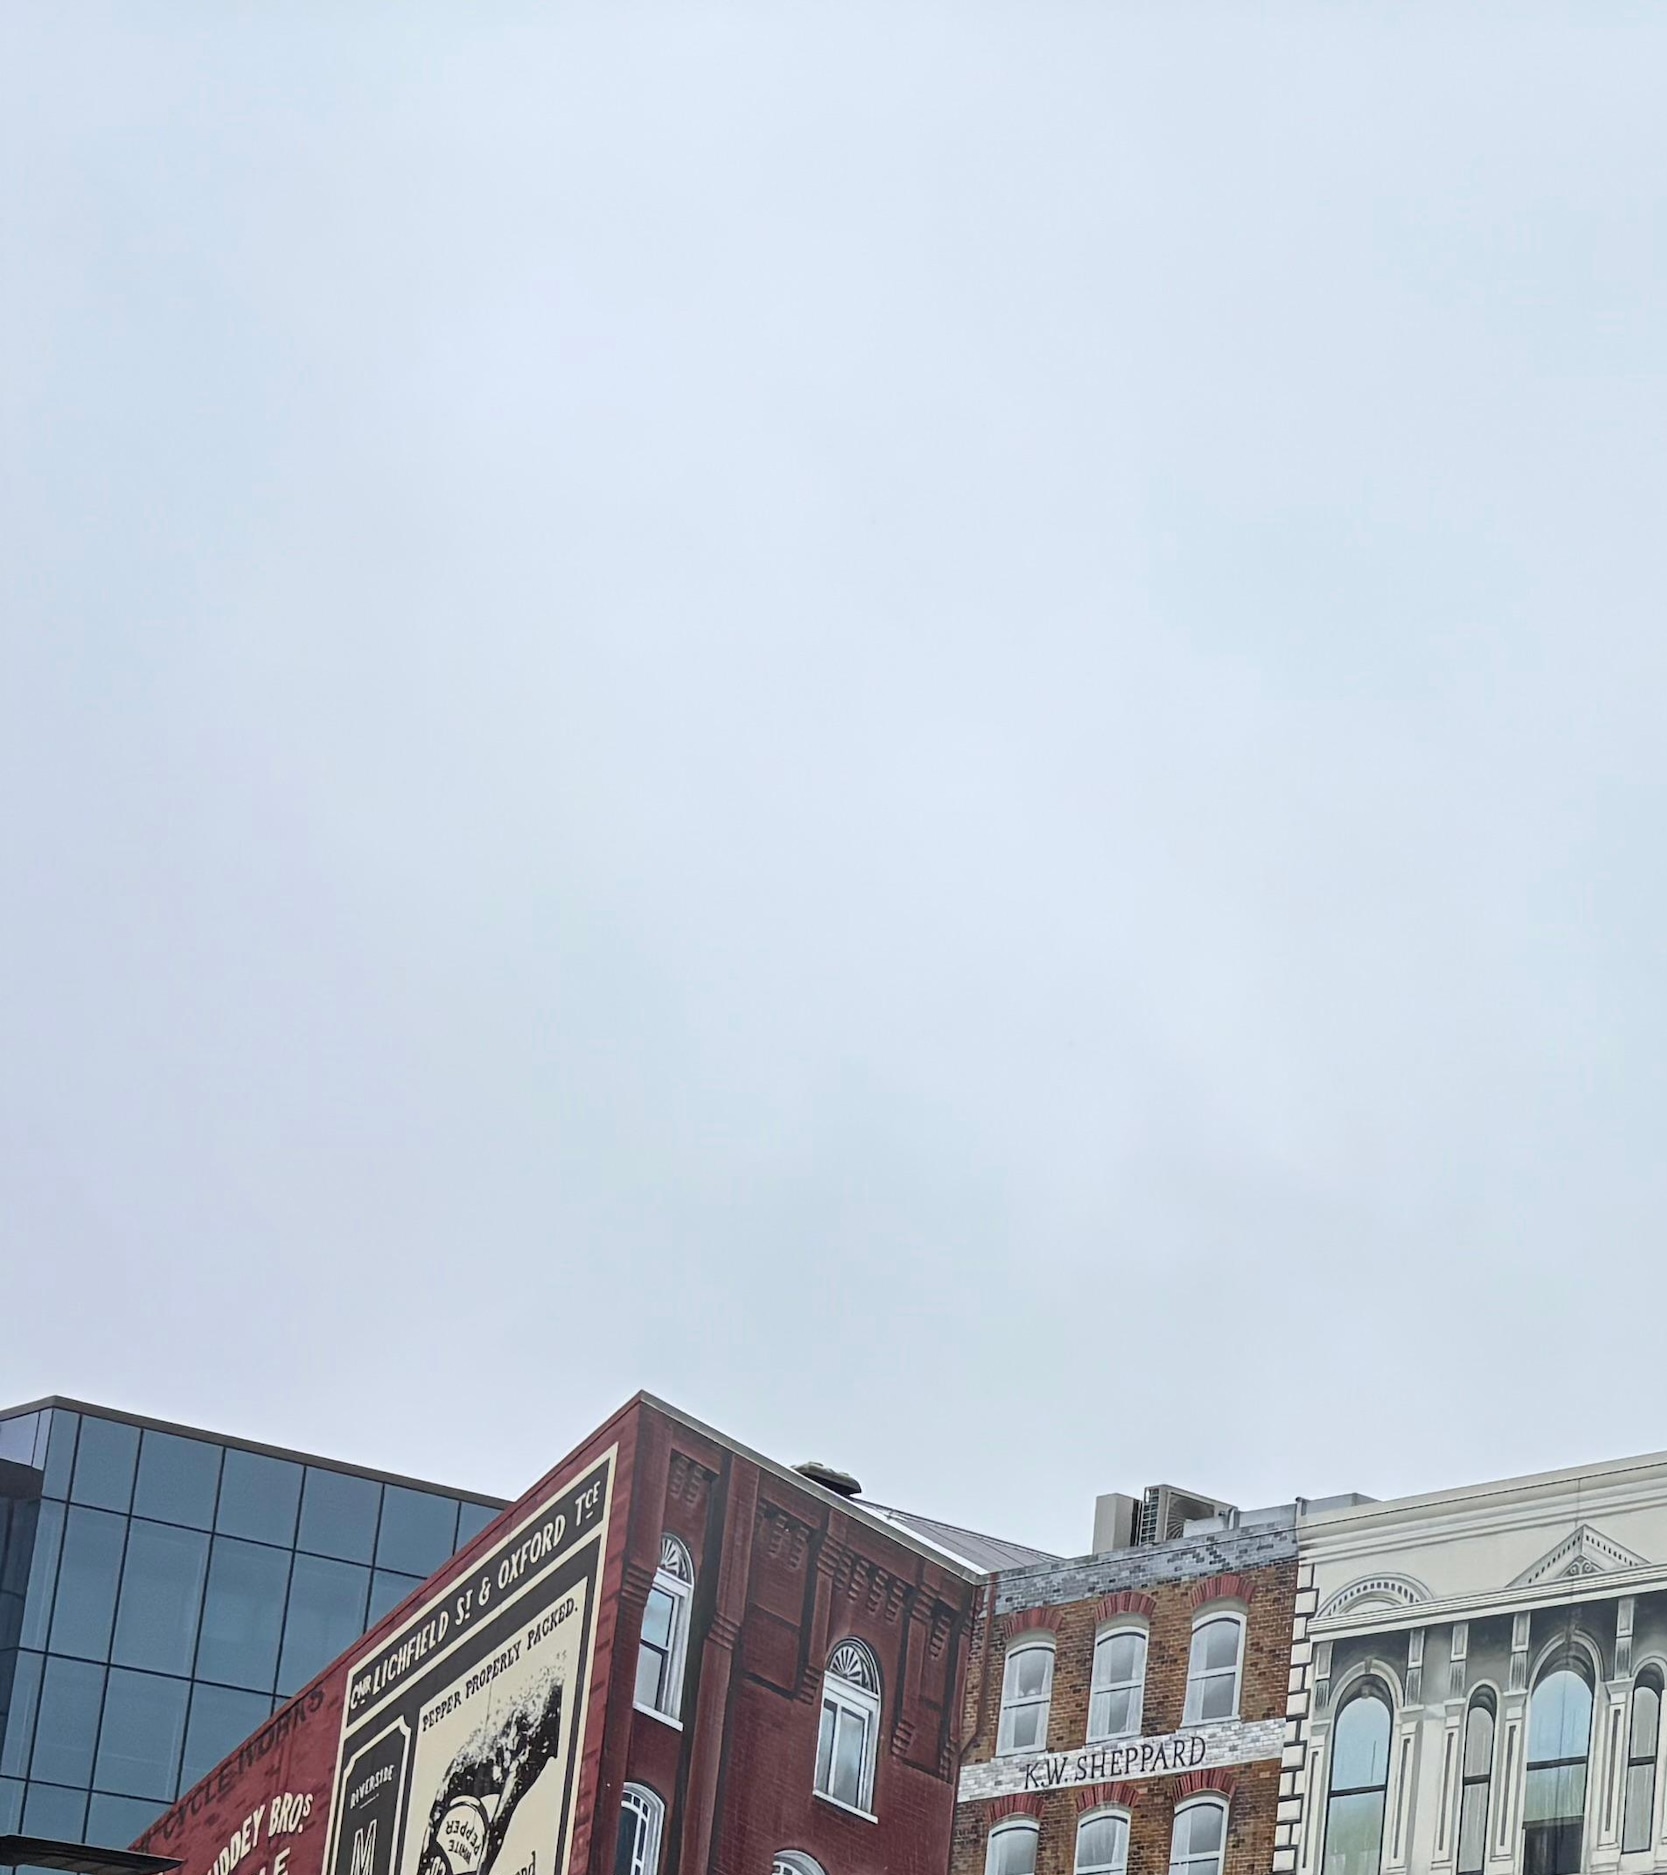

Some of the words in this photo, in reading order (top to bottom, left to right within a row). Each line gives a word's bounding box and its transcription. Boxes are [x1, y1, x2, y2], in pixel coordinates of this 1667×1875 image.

[372, 1610, 449, 1695] LICHFIELD
[478, 1577, 491, 1606] &
[498, 1514, 565, 1590] OXFORD
[422, 1690, 462, 1732] PEPPER
[466, 1640, 522, 1698] PROPERLY
[349, 1763, 395, 1810] RIVERSIDE
[1075, 1736, 1206, 1782] SHEPPARD
